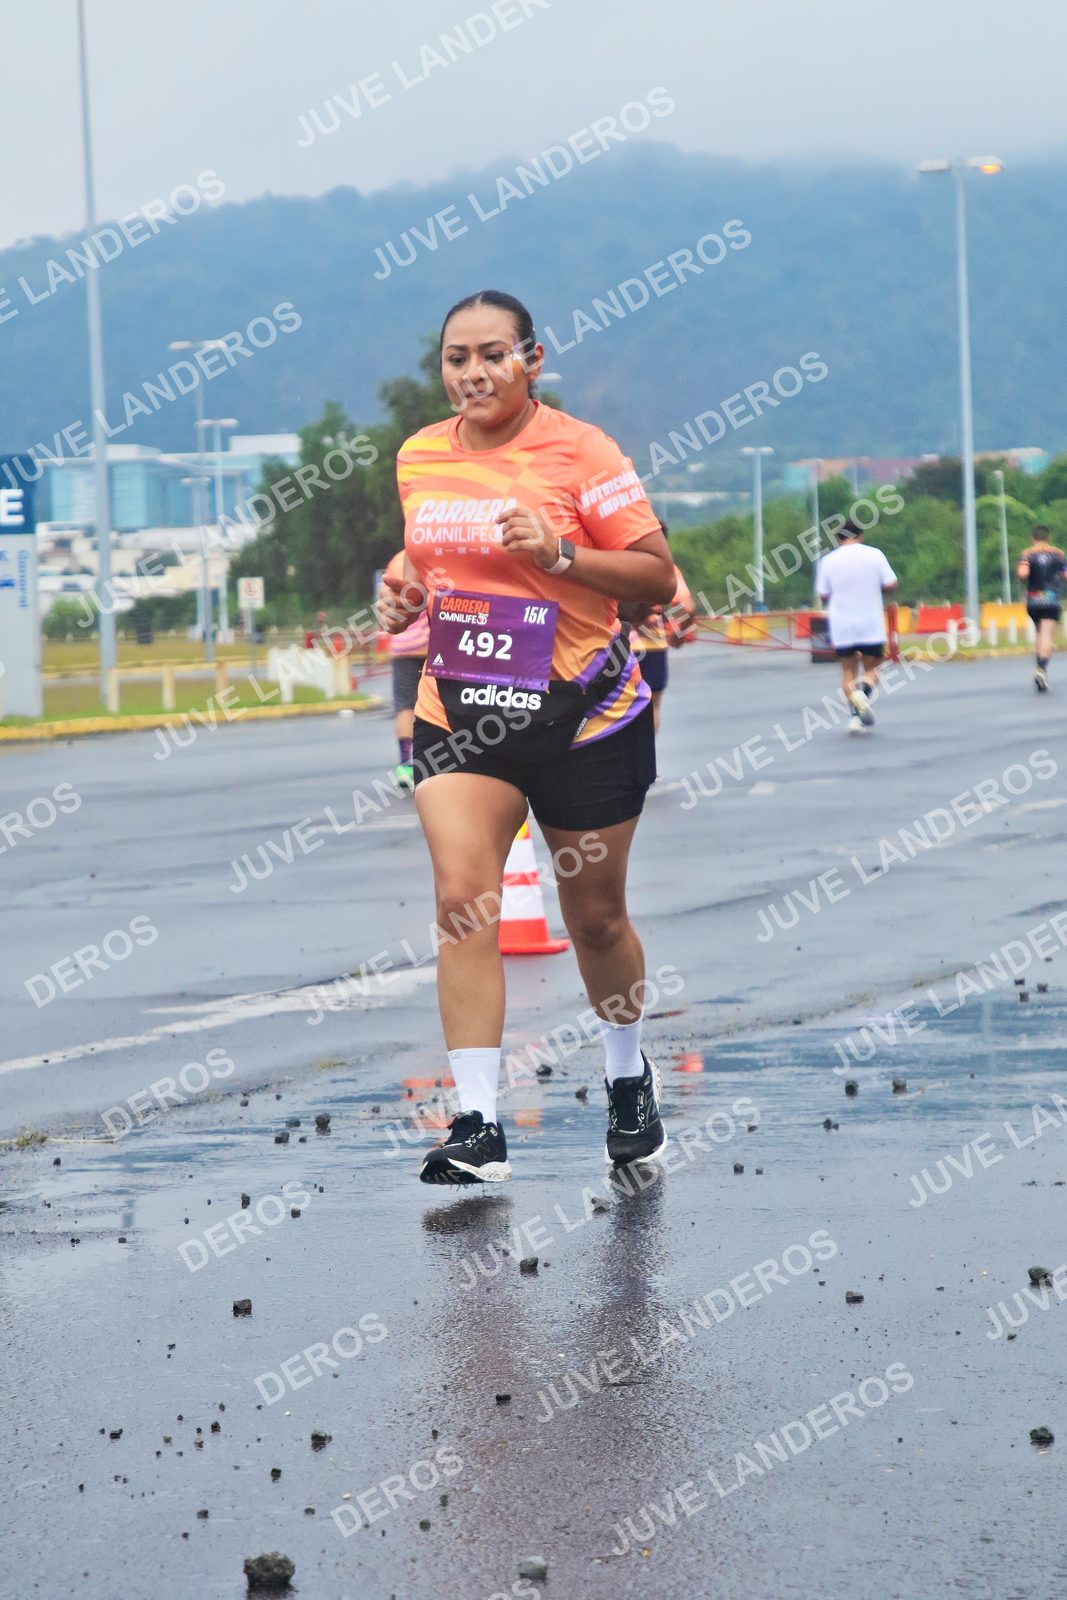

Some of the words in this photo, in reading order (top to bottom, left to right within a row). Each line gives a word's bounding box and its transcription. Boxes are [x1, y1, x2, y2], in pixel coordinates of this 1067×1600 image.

[440, 597, 490, 613] CARRERA
[523, 605, 548, 624] 15K
[458, 630, 513, 660] 492
[461, 685, 541, 710] adidas
